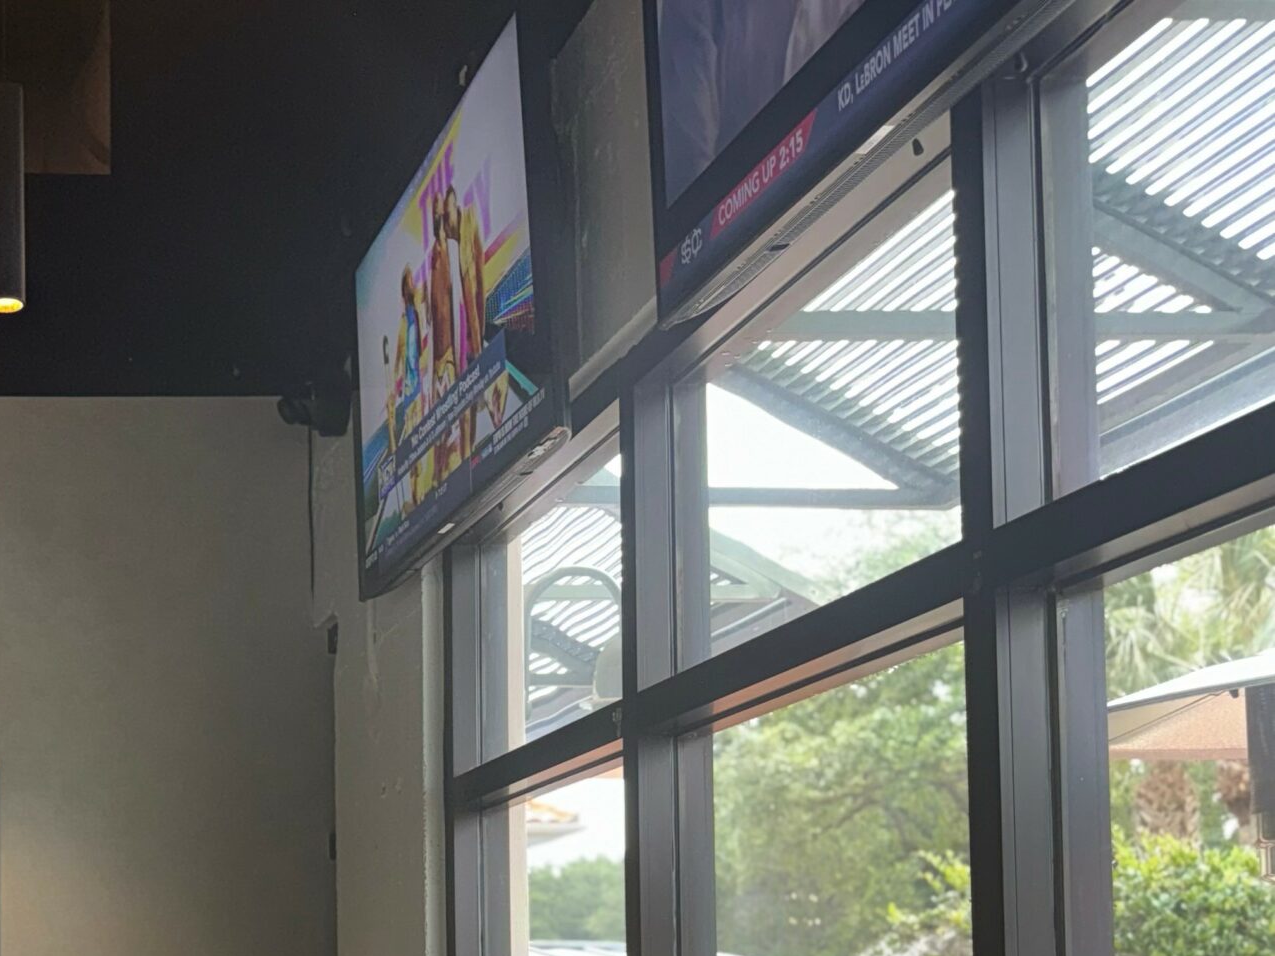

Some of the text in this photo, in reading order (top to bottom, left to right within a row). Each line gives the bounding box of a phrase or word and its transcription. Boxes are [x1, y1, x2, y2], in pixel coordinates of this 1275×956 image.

[837, 81, 854, 112] KD,
[892, 12, 920, 59] MEET
[922, 0, 934, 31] IN
[718, 129, 803, 226] COMING UP 2:15
[459, 363, 481, 396] Podcast
